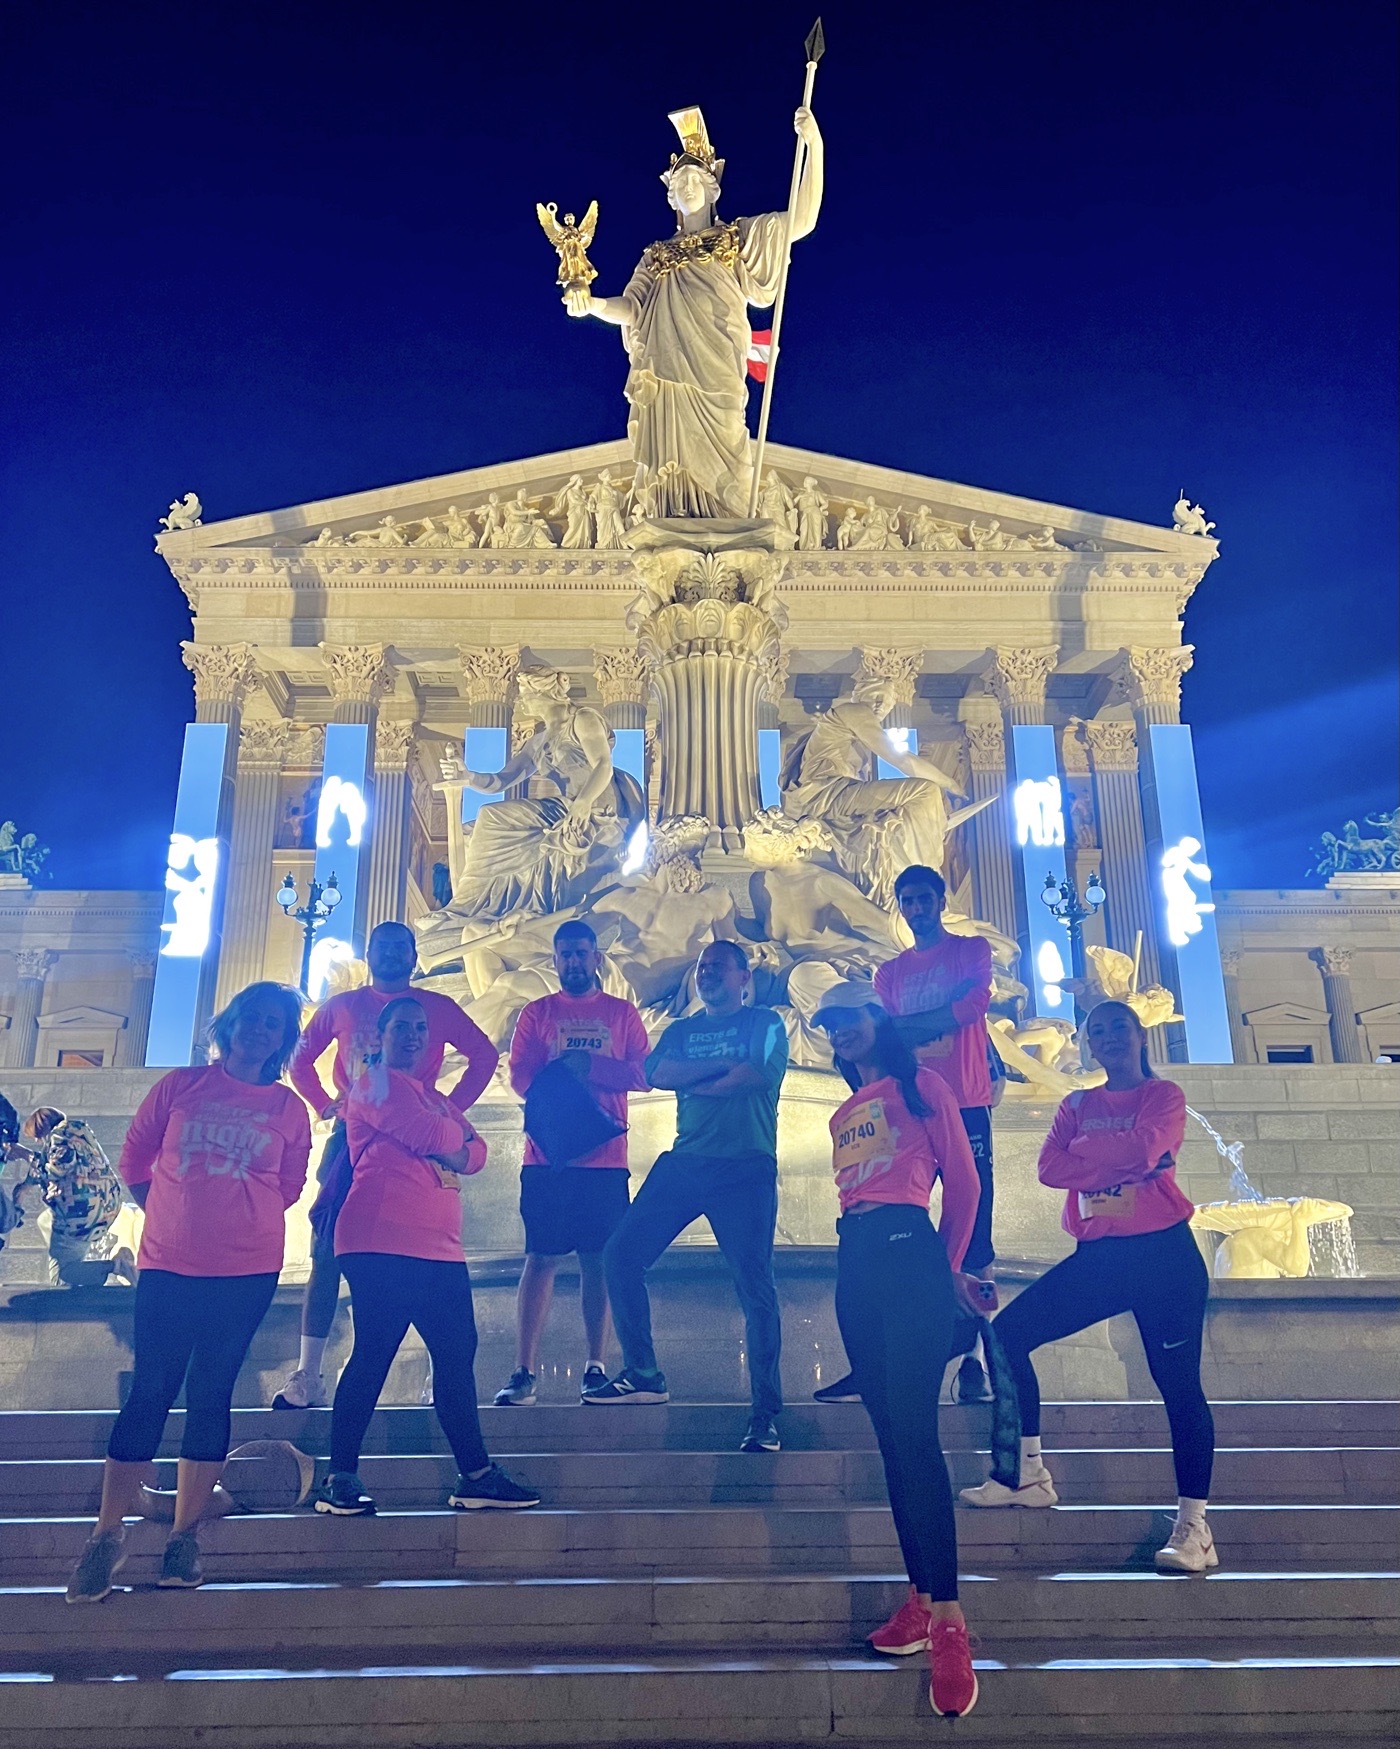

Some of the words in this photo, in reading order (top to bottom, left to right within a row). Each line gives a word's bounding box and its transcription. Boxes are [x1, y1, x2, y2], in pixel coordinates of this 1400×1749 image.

[566, 1037, 602, 1049] 20743
[689, 1030, 725, 1043] ERSTE
[838, 1121, 875, 1149] 20740
[613, 1379, 635, 1395] N
